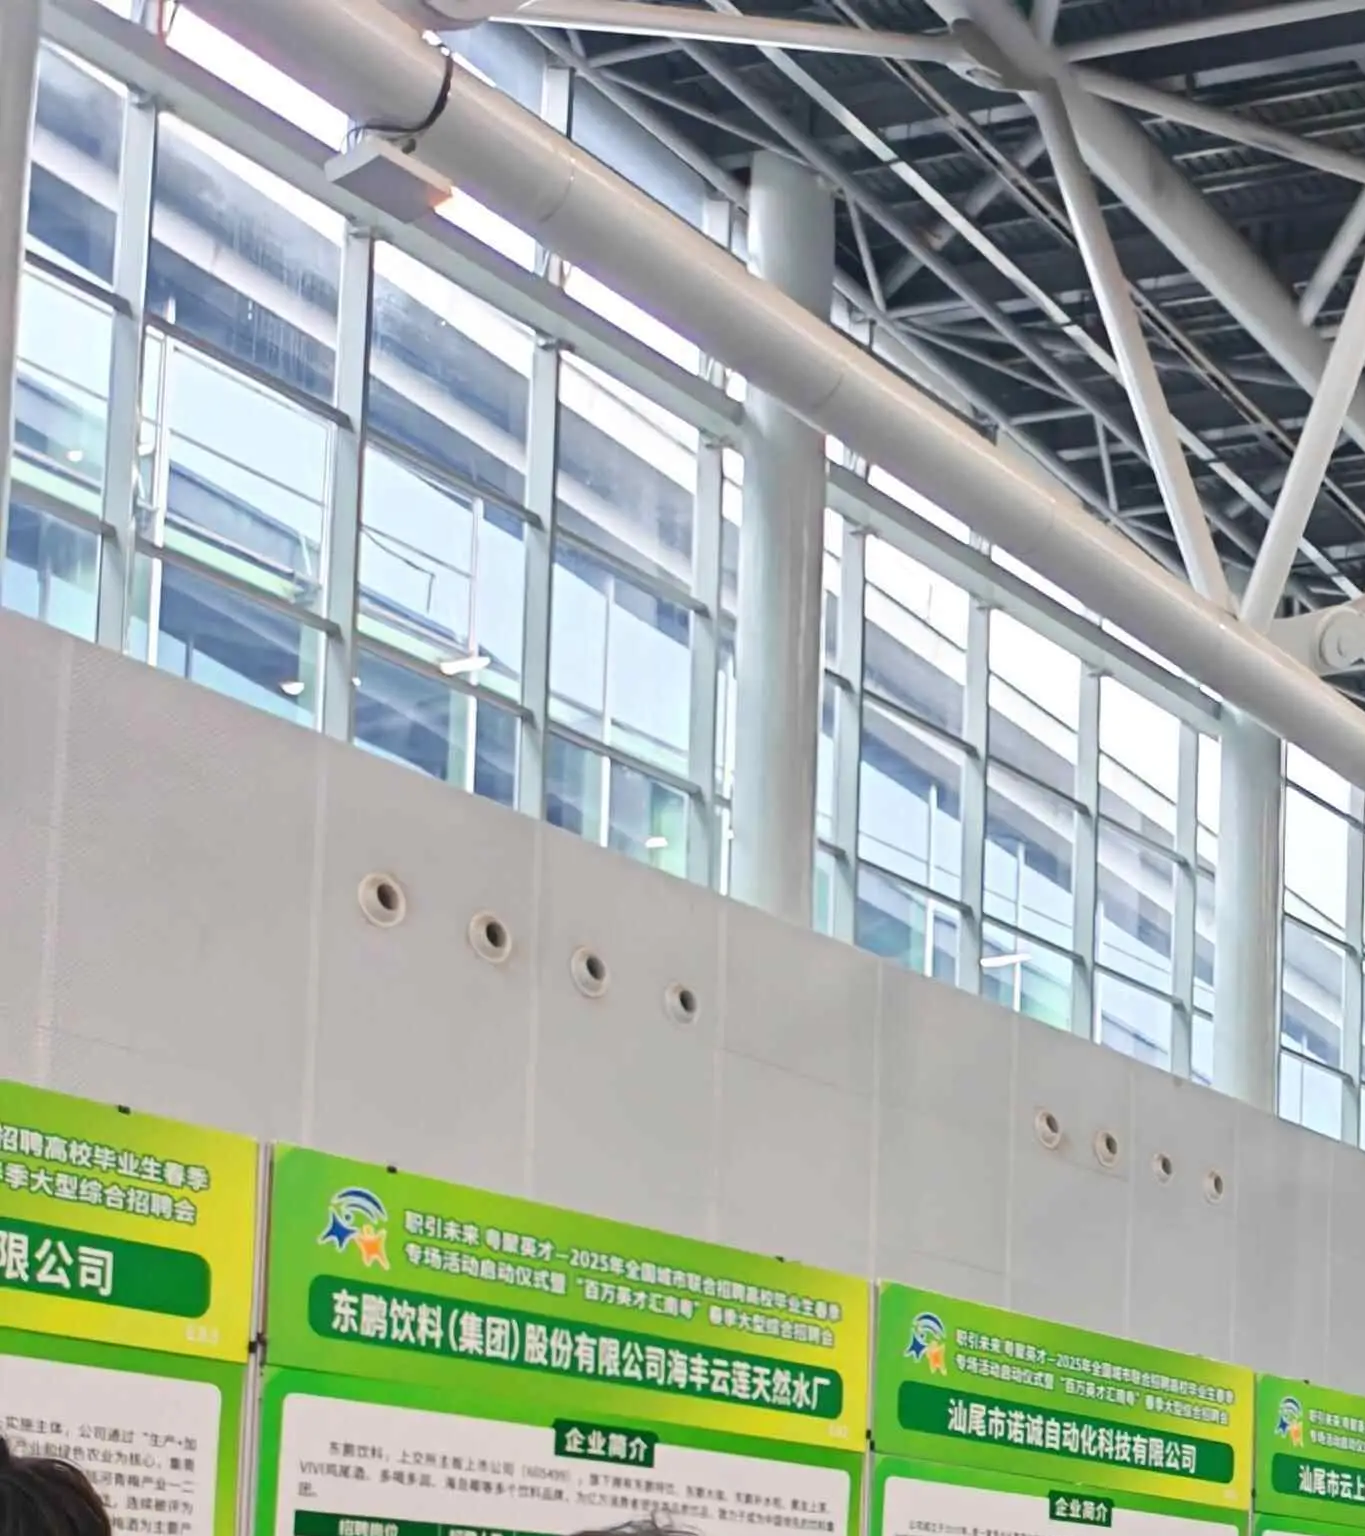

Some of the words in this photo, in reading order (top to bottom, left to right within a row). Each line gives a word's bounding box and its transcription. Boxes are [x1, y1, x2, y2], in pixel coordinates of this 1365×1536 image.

[0, 1165, 197, 1224] 季大型综合招聘会
[403, 1209, 480, 1247] 职引未来
[0, 1415, 197, 1451] 实施主体，公司通过“生产+加
[564, 1427, 648, 1463] 企业简介
[947, 1399, 1197, 1474] 汕尾市诺诚自动化科技有限公司
[1055, 1497, 1107, 1524] 企业简介
